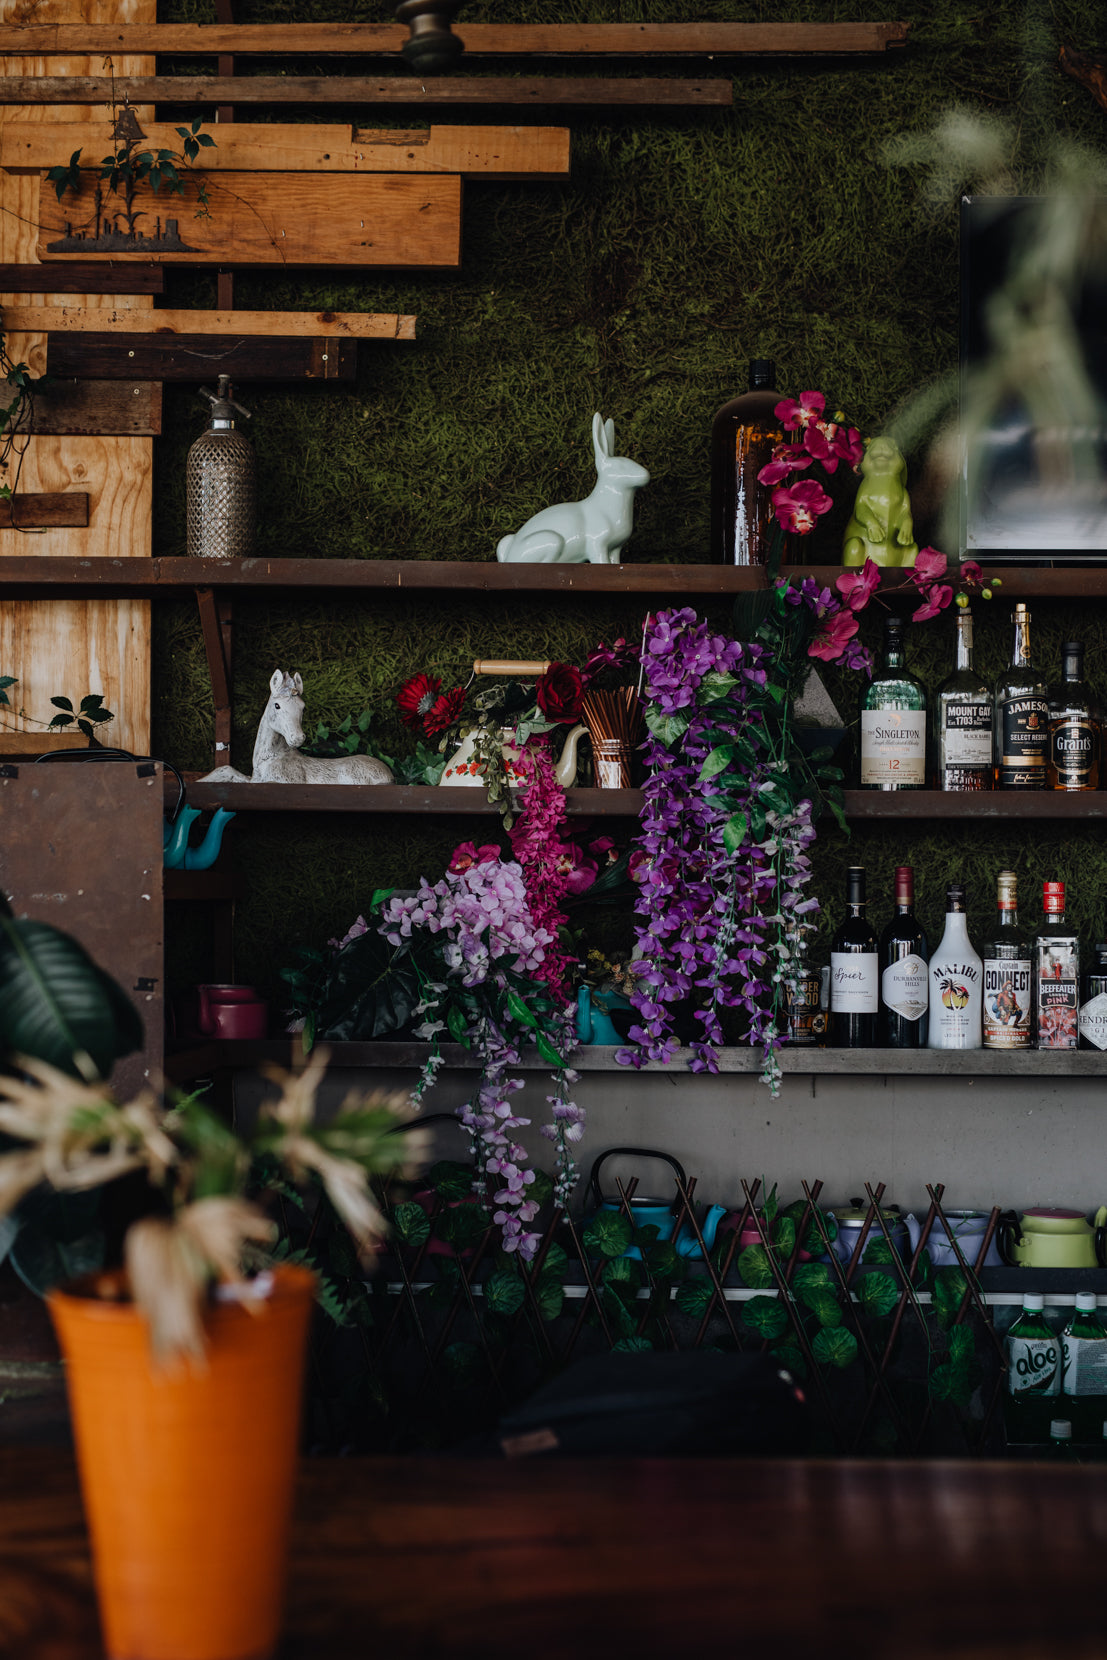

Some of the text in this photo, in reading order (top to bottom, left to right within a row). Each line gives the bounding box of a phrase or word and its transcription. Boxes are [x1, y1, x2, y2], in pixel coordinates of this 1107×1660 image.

[948, 706, 991, 717] MOUNT GAY
[956, 716, 974, 726] 1703
[876, 727, 920, 739] SINGLETON
[1057, 737, 1091, 751] Grant's
[889, 760, 900, 770] 12
[933, 963, 980, 984] MALIBU
[986, 970, 1030, 991] CONNECT
[1040, 984, 1076, 995] BEEFEATER
[1046, 996, 1070, 1004] PINK
[1016, 1343, 1057, 1376] aloe
